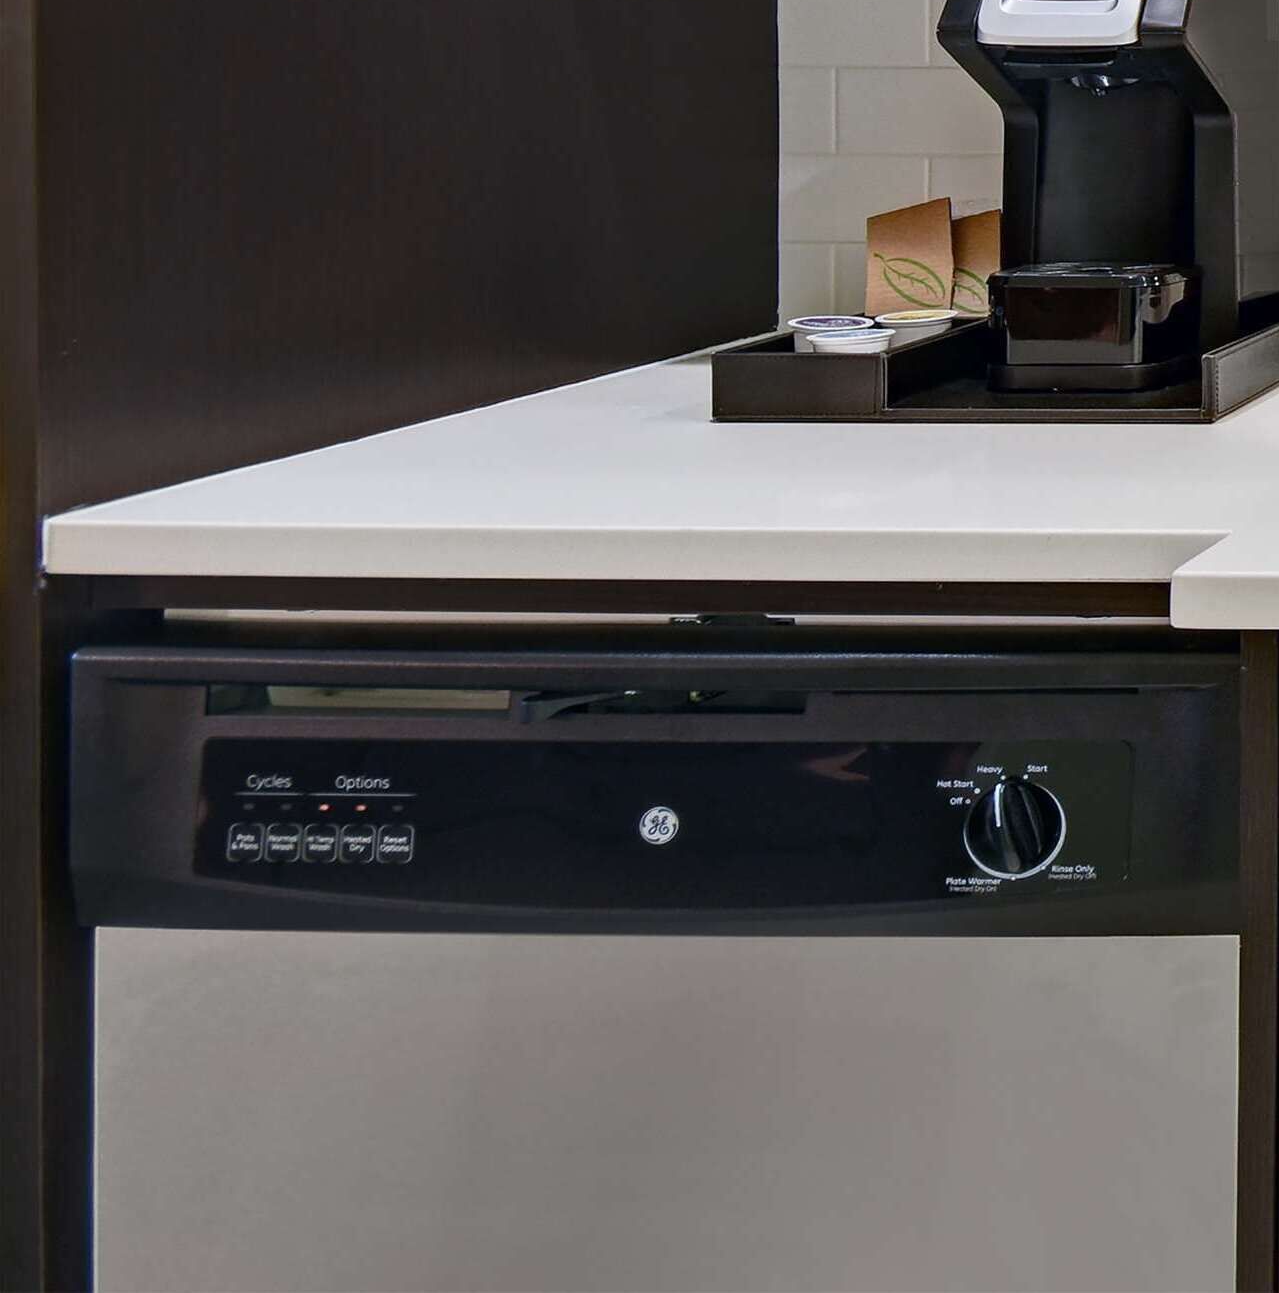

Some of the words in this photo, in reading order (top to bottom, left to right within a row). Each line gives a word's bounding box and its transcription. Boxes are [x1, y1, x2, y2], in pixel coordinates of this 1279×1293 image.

[977, 765, 1003, 775] Heavy
[1027, 764, 1048, 773] Start
[246, 774, 293, 791] Cycles
[335, 775, 391, 792] Options
[936, 780, 952, 788] Hot
[953, 780, 974, 788] Start
[949, 797, 964, 806] Off
[383, 835, 408, 844] Reset
[349, 843, 365, 854] Dry
[380, 844, 410, 853] Options
[1052, 865, 1074, 873] Rinse
[1074, 865, 1095, 875] Only
[945, 877, 967, 886] Plate
[967, 877, 1002, 886] Warmer
